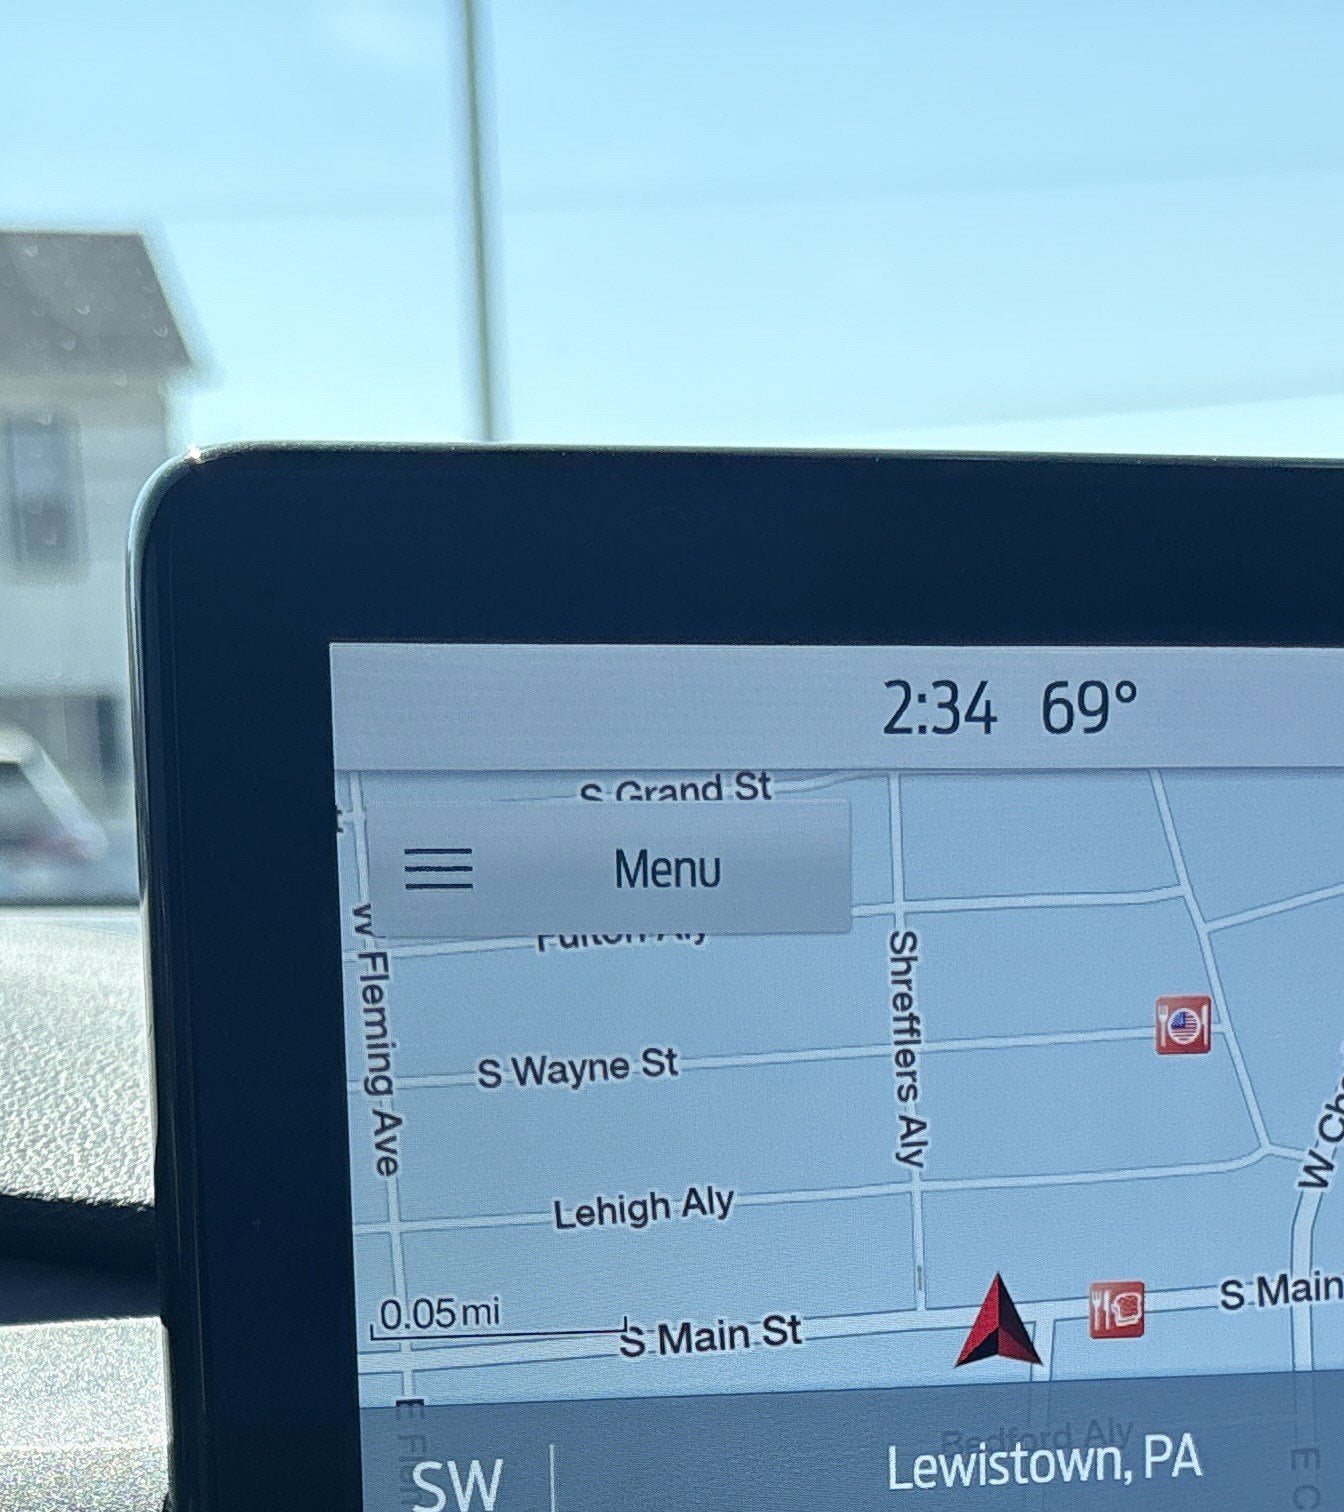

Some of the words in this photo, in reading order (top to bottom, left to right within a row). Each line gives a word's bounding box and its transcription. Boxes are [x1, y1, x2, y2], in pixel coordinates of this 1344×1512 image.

[883, 679, 998, 735] 2:34
[1042, 679, 1137, 735] 69°
[615, 773, 723, 801] Grand
[734, 770, 772, 801] St
[615, 848, 721, 889] Menu
[357, 951, 397, 1096] Fleming
[889, 930, 923, 1103] Shrefflers
[477, 1058, 502, 1088] S
[512, 1051, 630, 1090] Wayne
[642, 1046, 679, 1077] St
[372, 1108, 404, 1178] Ave
[895, 1114, 929, 1168] Aly
[1298, 1149, 1335, 1188] W
[555, 1191, 670, 1229] Lehigh
[681, 1187, 735, 1219] Aly
[1220, 1279, 1245, 1310] S
[1258, 1273, 1344, 1305] Main
[619, 1327, 645, 1358] S
[658, 1322, 750, 1355] Main
[762, 1315, 803, 1347] St
[888, 1440, 1132, 1490] Lewistown,
[1144, 1432, 1203, 1477] PA
